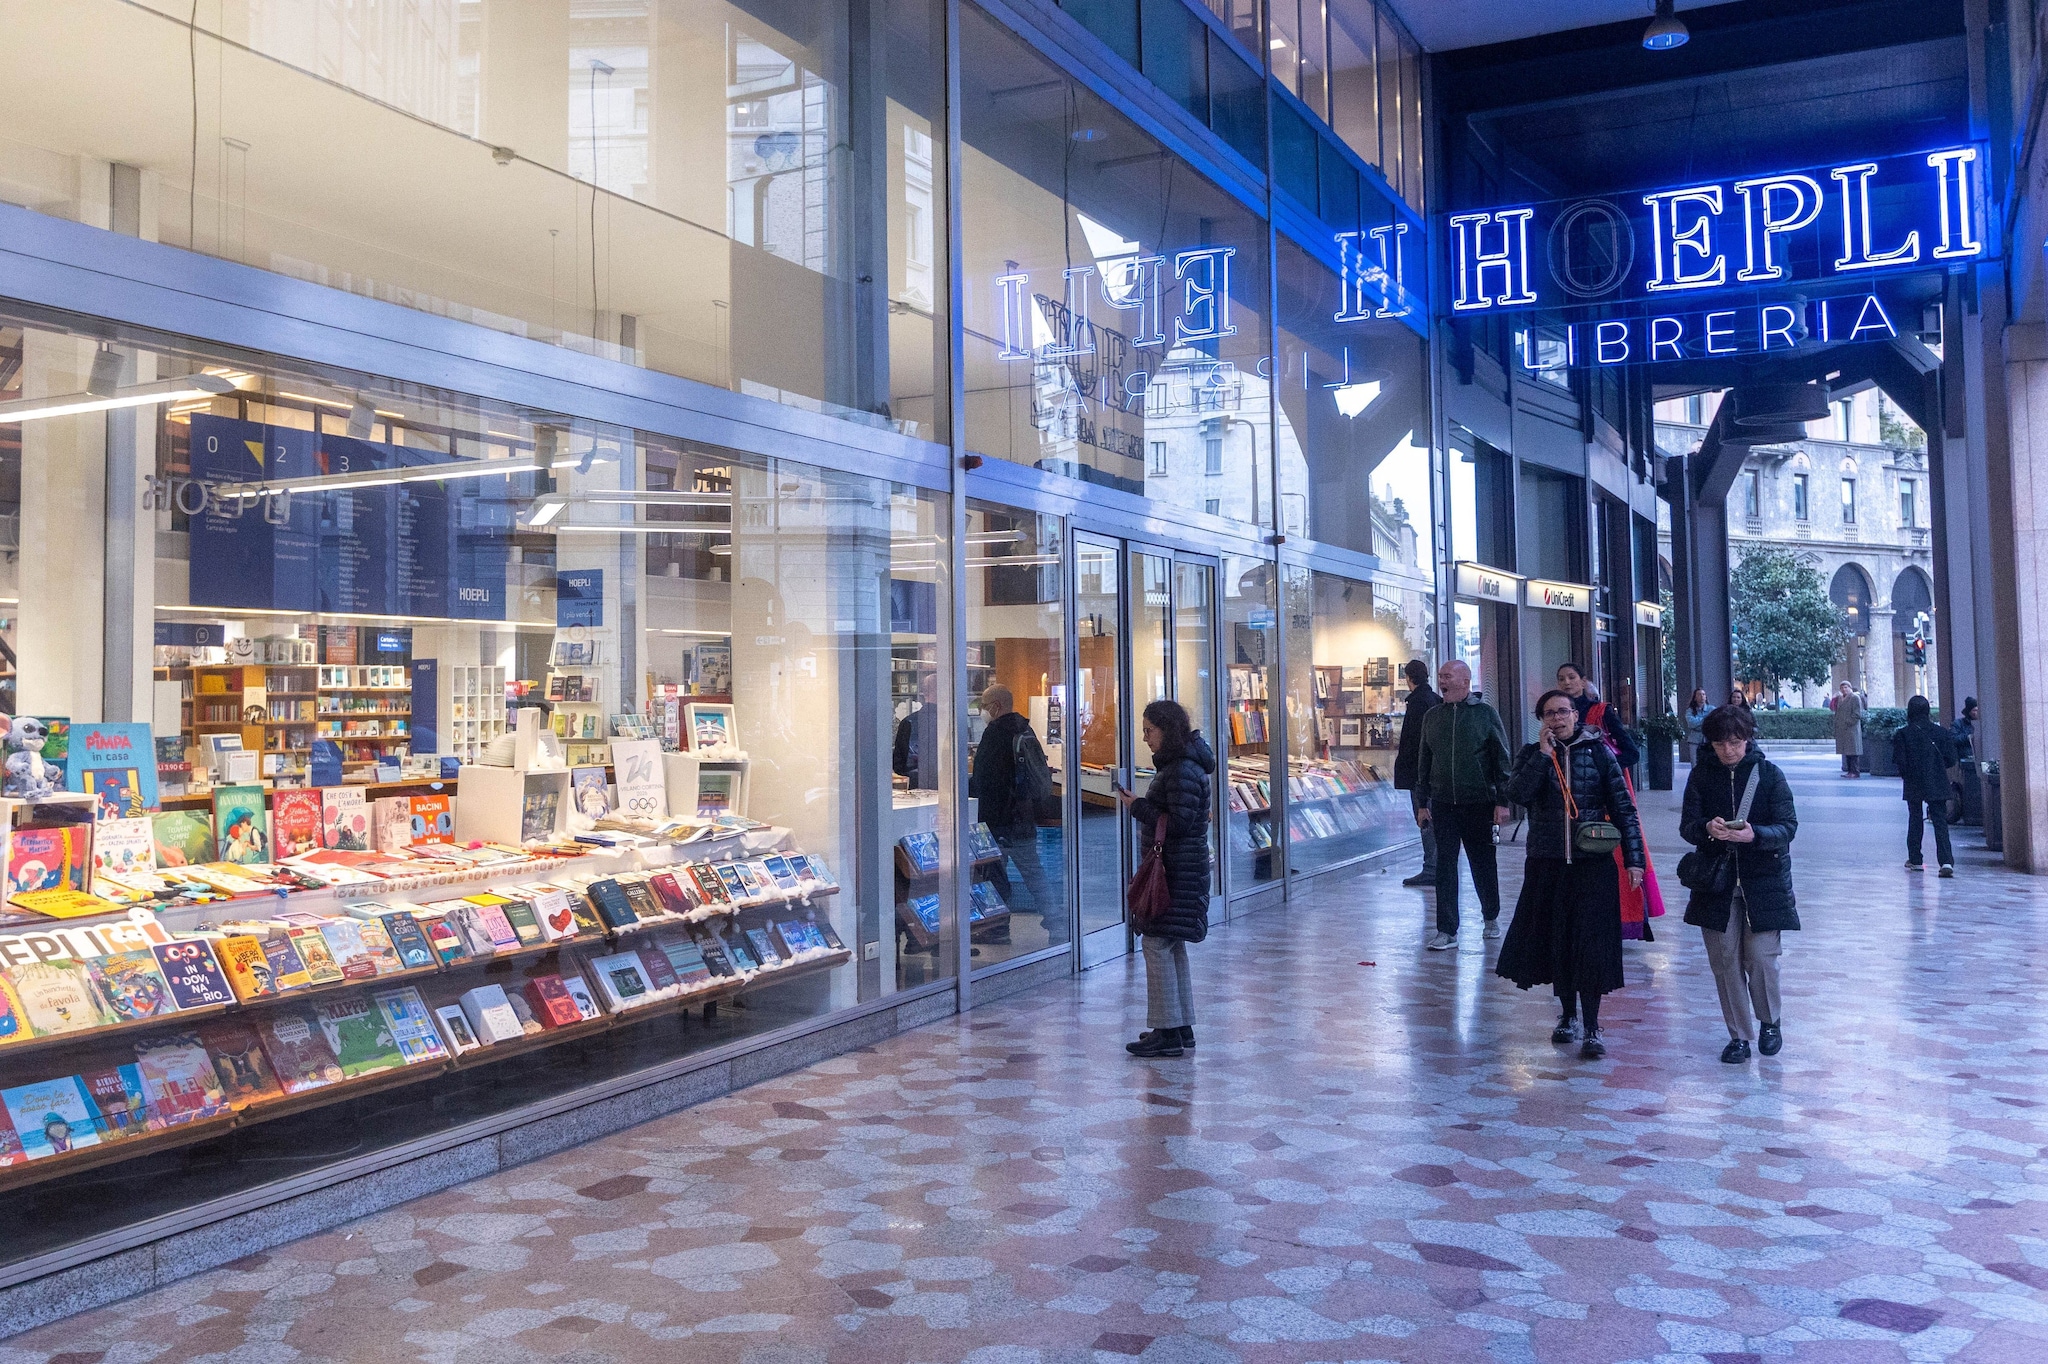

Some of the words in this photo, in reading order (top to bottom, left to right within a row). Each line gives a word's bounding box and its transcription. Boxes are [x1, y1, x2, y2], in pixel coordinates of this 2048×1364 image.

[1450, 148, 1981, 311] HOEPLI
[1523, 295, 1898, 369] LIBRERIA
[207, 436, 218, 453] 0
[276, 446, 287, 463] 2
[340, 456, 349, 472] 3
[568, 578, 591, 588] HOEPLI
[459, 587, 490, 602] HOEPLI
[1550, 591, 1575, 607] UniCredit
[92, 753, 102, 762] in
[106, 753, 129, 761] casa
[326, 792, 337, 800] CHE
[416, 803, 442, 812] BACINI
[485, 915, 506, 931] LOVE
[235, 950, 259, 963] LIBERA
[185, 964, 199, 975] IN
[182, 975, 210, 986] DOVI
[192, 984, 208, 994] NA
[47, 993, 81, 1008] favola
[203, 990, 223, 1002] RIO
[328, 1001, 368, 1019] MAPPE
[96, 1085, 115, 1095] DOVE
[23, 1093, 51, 1106] Dove
[20, 1103, 47, 1116] posso
